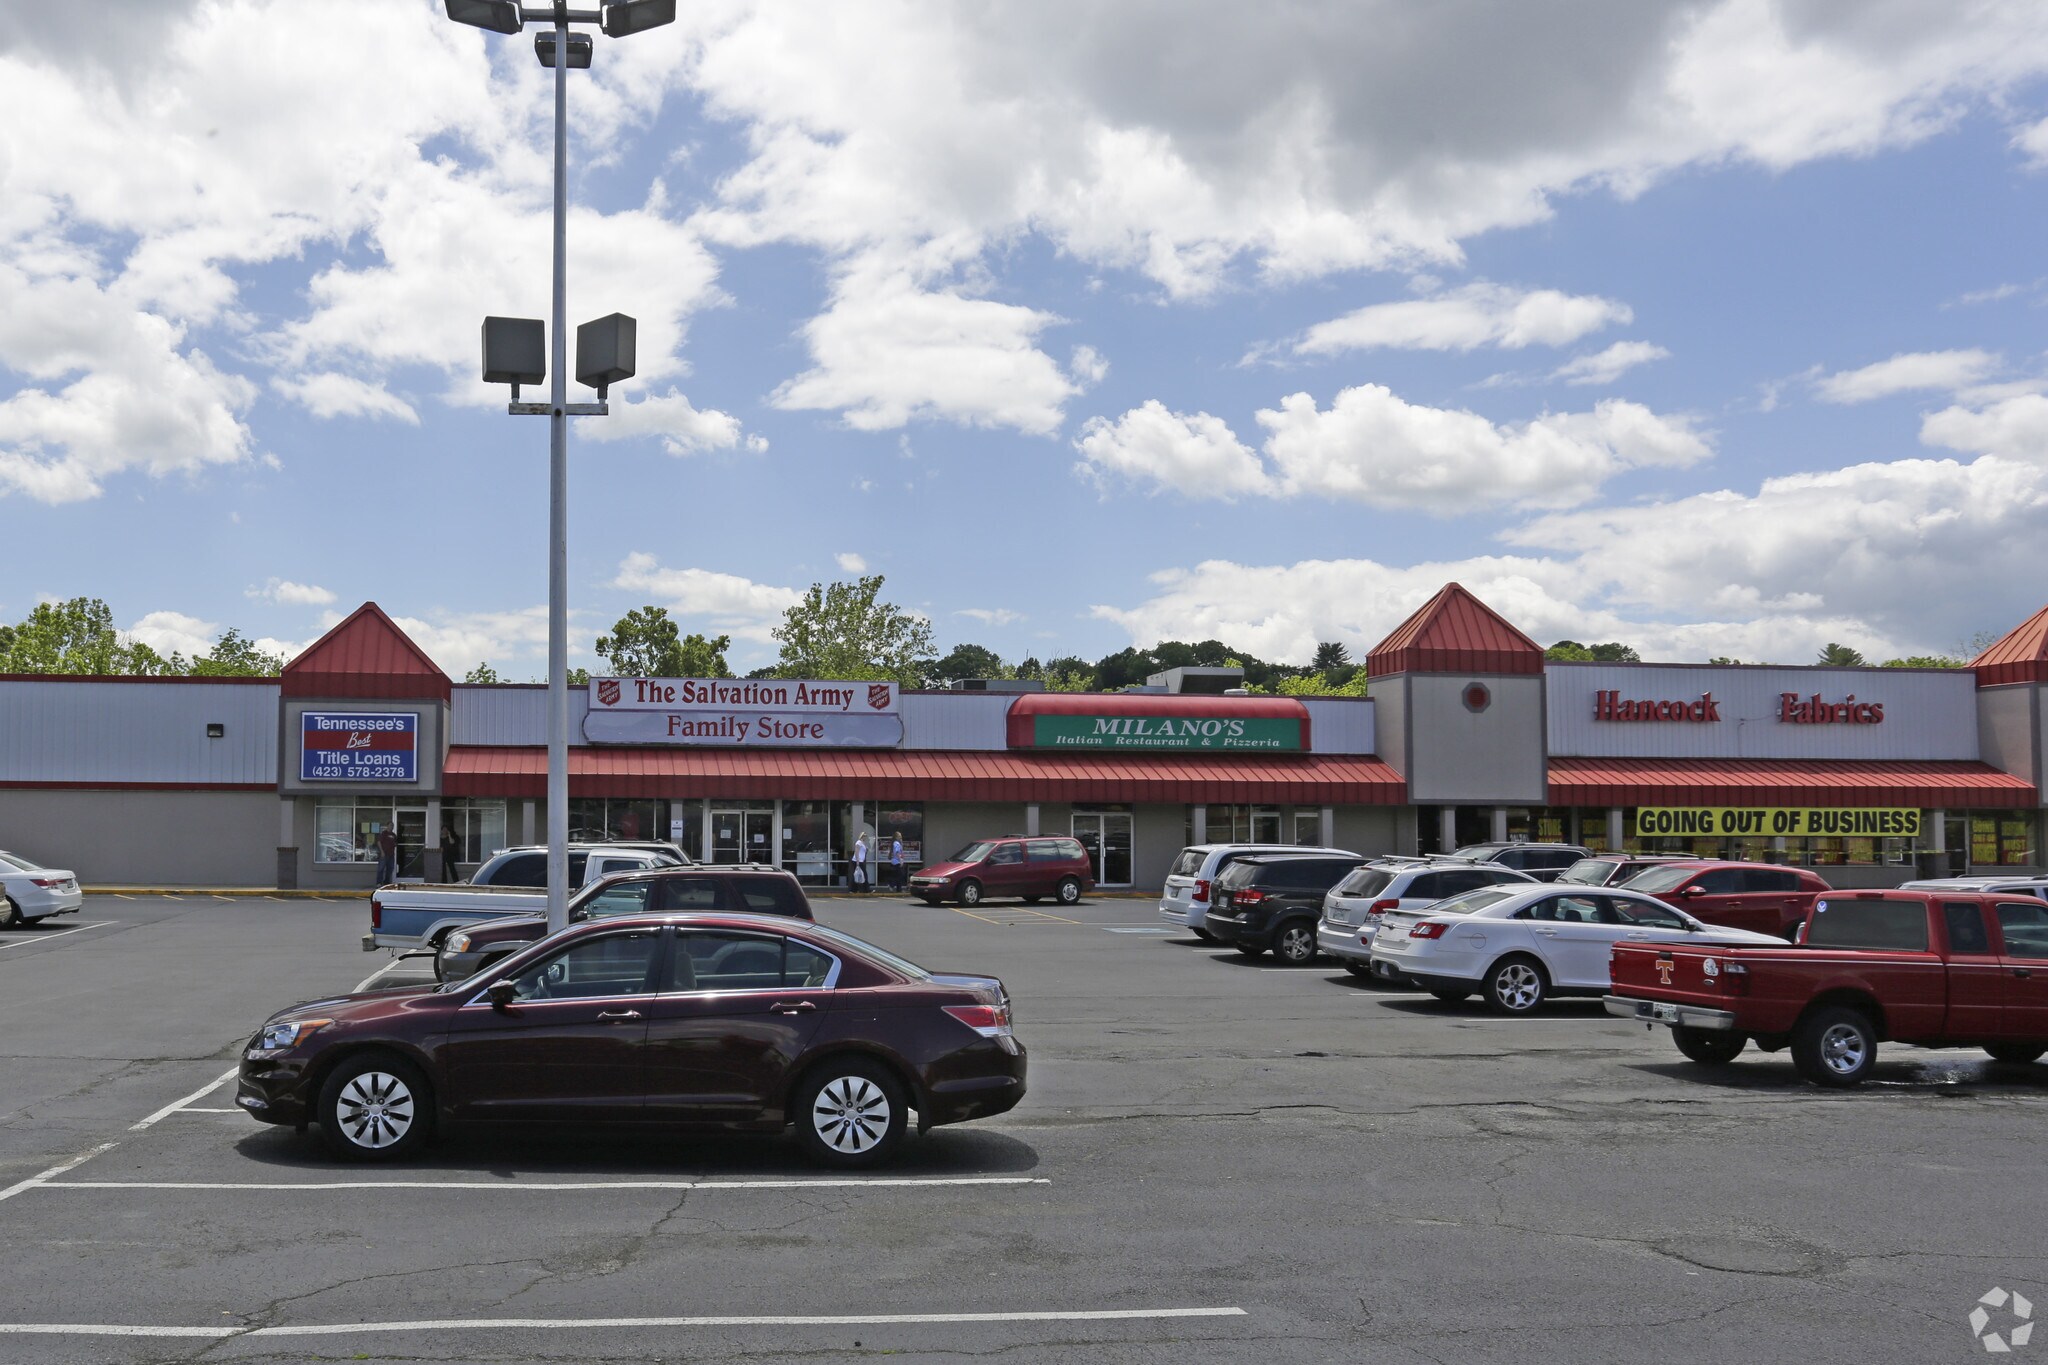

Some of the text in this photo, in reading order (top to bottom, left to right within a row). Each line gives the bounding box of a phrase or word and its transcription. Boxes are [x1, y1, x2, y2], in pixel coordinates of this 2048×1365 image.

[634, 679, 855, 711] The Salvation Army
[1594, 690, 1884, 725] Hancock Fabrics
[314, 716, 405, 731] Tennessee's
[667, 714, 824, 742] Family Store
[1092, 718, 1245, 737] MILANO'S
[346, 731, 372, 749] Best
[1056, 735, 1281, 748] Italian Restaurant & Pizzeria
[317, 751, 401, 765] Title Loans
[312, 766, 405, 778] (423) 578-2378
[1639, 810, 1918, 834] GOING OUT OF BUSINESS
[1655, 960, 1674, 984] T
